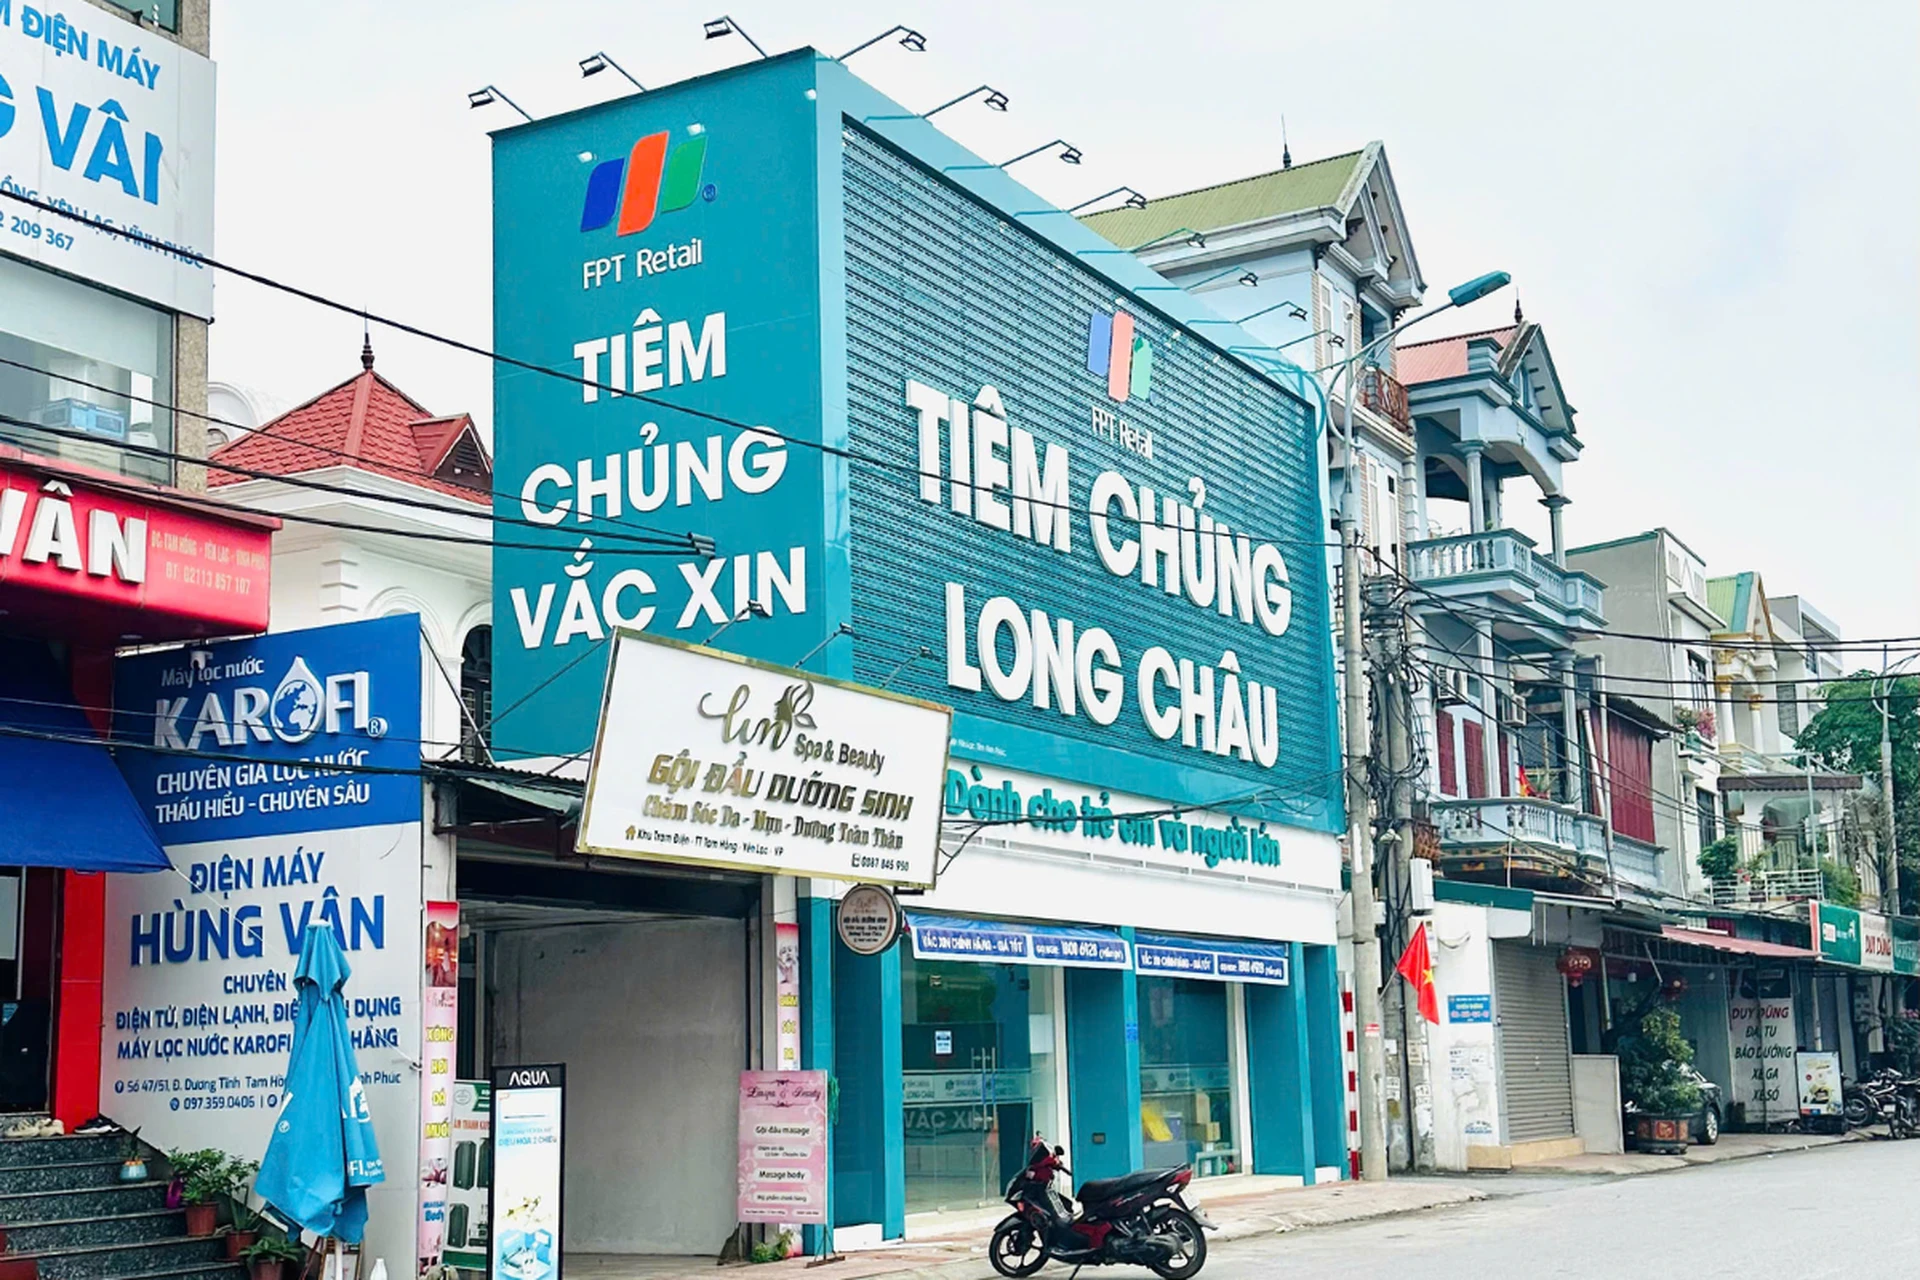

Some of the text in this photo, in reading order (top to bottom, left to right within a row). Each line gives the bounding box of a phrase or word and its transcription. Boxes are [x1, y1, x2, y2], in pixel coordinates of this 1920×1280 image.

[21, 5, 89, 61] ĐIỆN
[97, 38, 161, 91] MÁY
[11, 215, 43, 239] 209
[45, 227, 75, 251] 367
[583, 237, 703, 289] FPT Retail
[574, 307, 728, 403] TIÊM
[1092, 405, 1153, 459] FPT Retail
[520, 422, 788, 527] CHỦNG
[905, 378, 1292, 637] TIÊM CHỦNG
[510, 537, 807, 650] VẮC XIN
[225, 654, 265, 679] nước
[945, 581, 1280, 769] LONG CHÂU
[793, 733, 823, 762] Spa
[838, 743, 886, 777] Beauty
[156, 763, 231, 795] CHUYÊN
[155, 795, 201, 824] THẤU
[204, 790, 245, 818] HIỂU
[259, 784, 330, 813] CHUYÊN
[333, 780, 371, 805] SÂU
[858, 789, 915, 821] SINH
[945, 764, 1022, 826] Dành
[1027, 788, 1077, 834] cho
[1118, 814, 1156, 847] em
[1190, 815, 1249, 869] người
[1250, 821, 1282, 867] lớn
[190, 846, 326, 899] ĐIỆN MÁY
[130, 898, 264, 967] HÙNG
[223, 968, 287, 995] CHUYÊN
[115, 1006, 152, 1034] ĐIỆN
[182, 1003, 219, 1031] ĐIỆN
[354, 996, 402, 1021] DỤNG
[1731, 1006, 1756, 1020] DUY
[117, 1036, 151, 1060] MÁY
[154, 1037, 184, 1063] LỌC
[187, 1032, 230, 1057] NƯỚC
[425, 1024, 455, 1043] XÔNG
[244, 1075, 269, 1089] Tam
[509, 1070, 551, 1086] AQUA
[1765, 1068, 1779, 1081] GA
[787, 1171, 806, 1180] body
